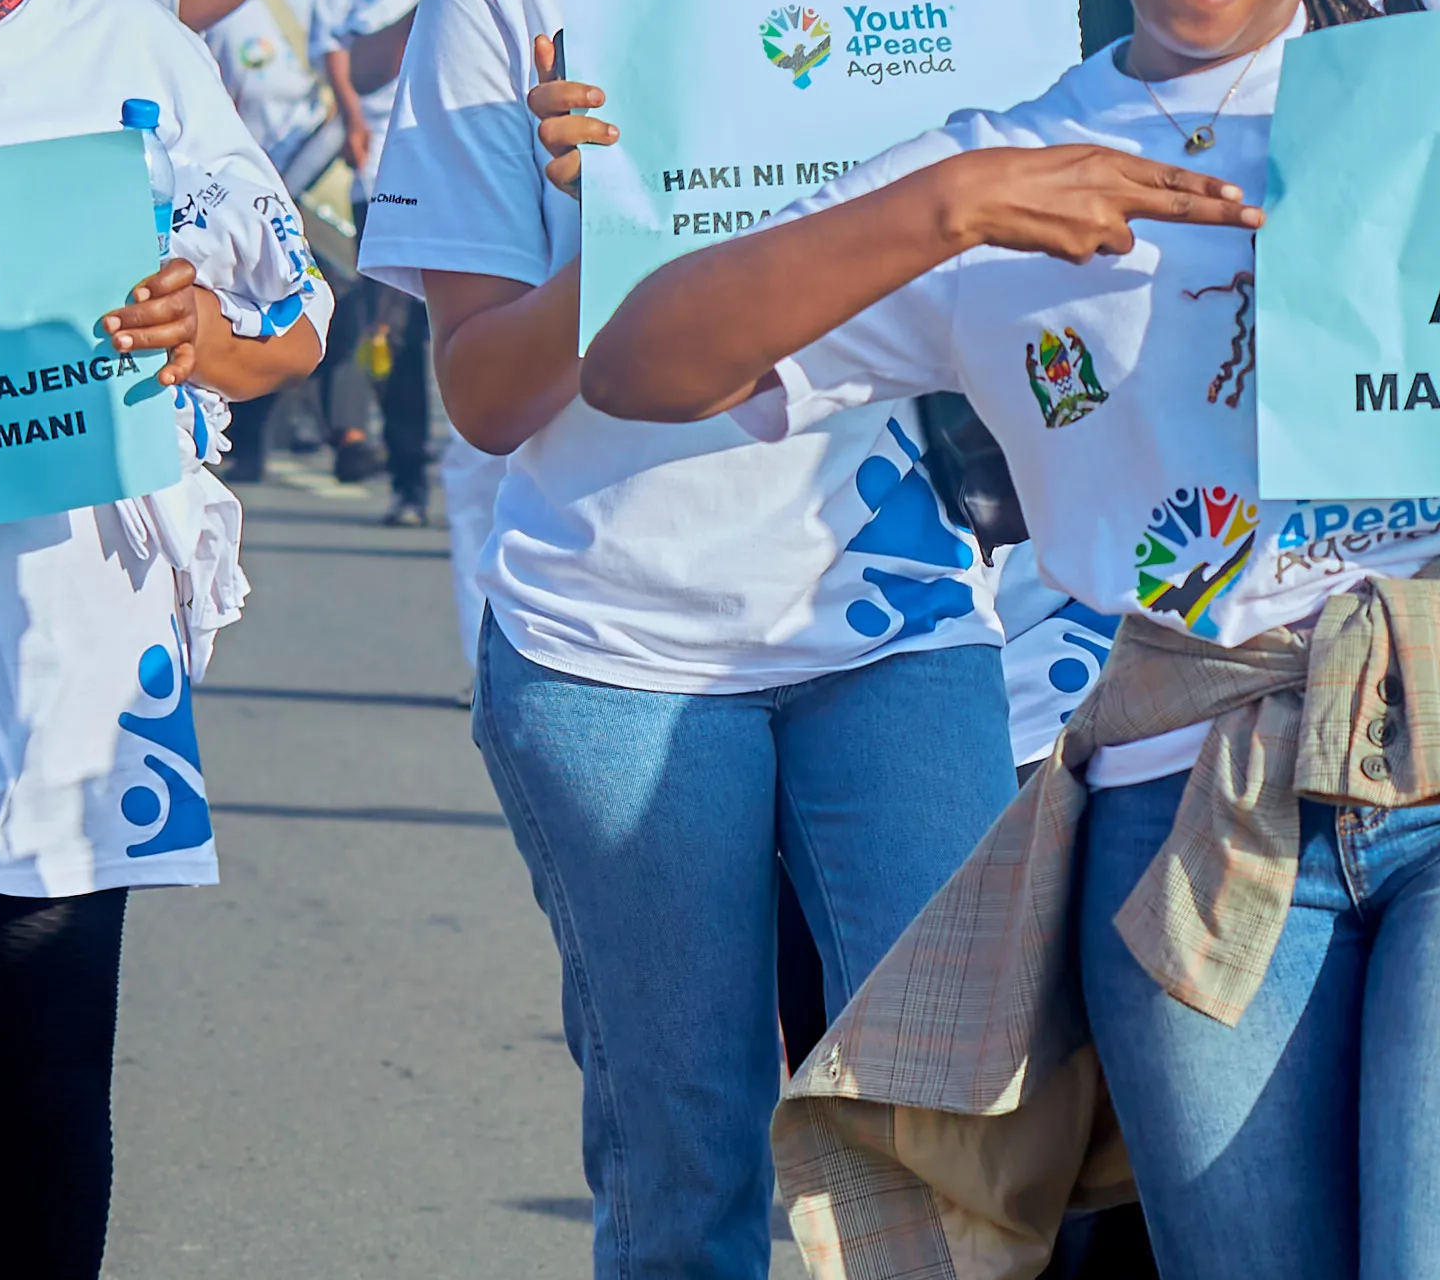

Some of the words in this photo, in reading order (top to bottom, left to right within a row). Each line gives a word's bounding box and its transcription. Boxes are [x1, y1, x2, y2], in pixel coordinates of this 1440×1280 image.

[844, 2, 948, 33] Youth
[846, 33, 953, 56] 4Peace
[847, 54, 956, 85] Agenda
[663, 166, 741, 192] HAKI
[753, 164, 784, 187] NI
[796, 160, 860, 185] MSI
[377, 193, 418, 206] Children
